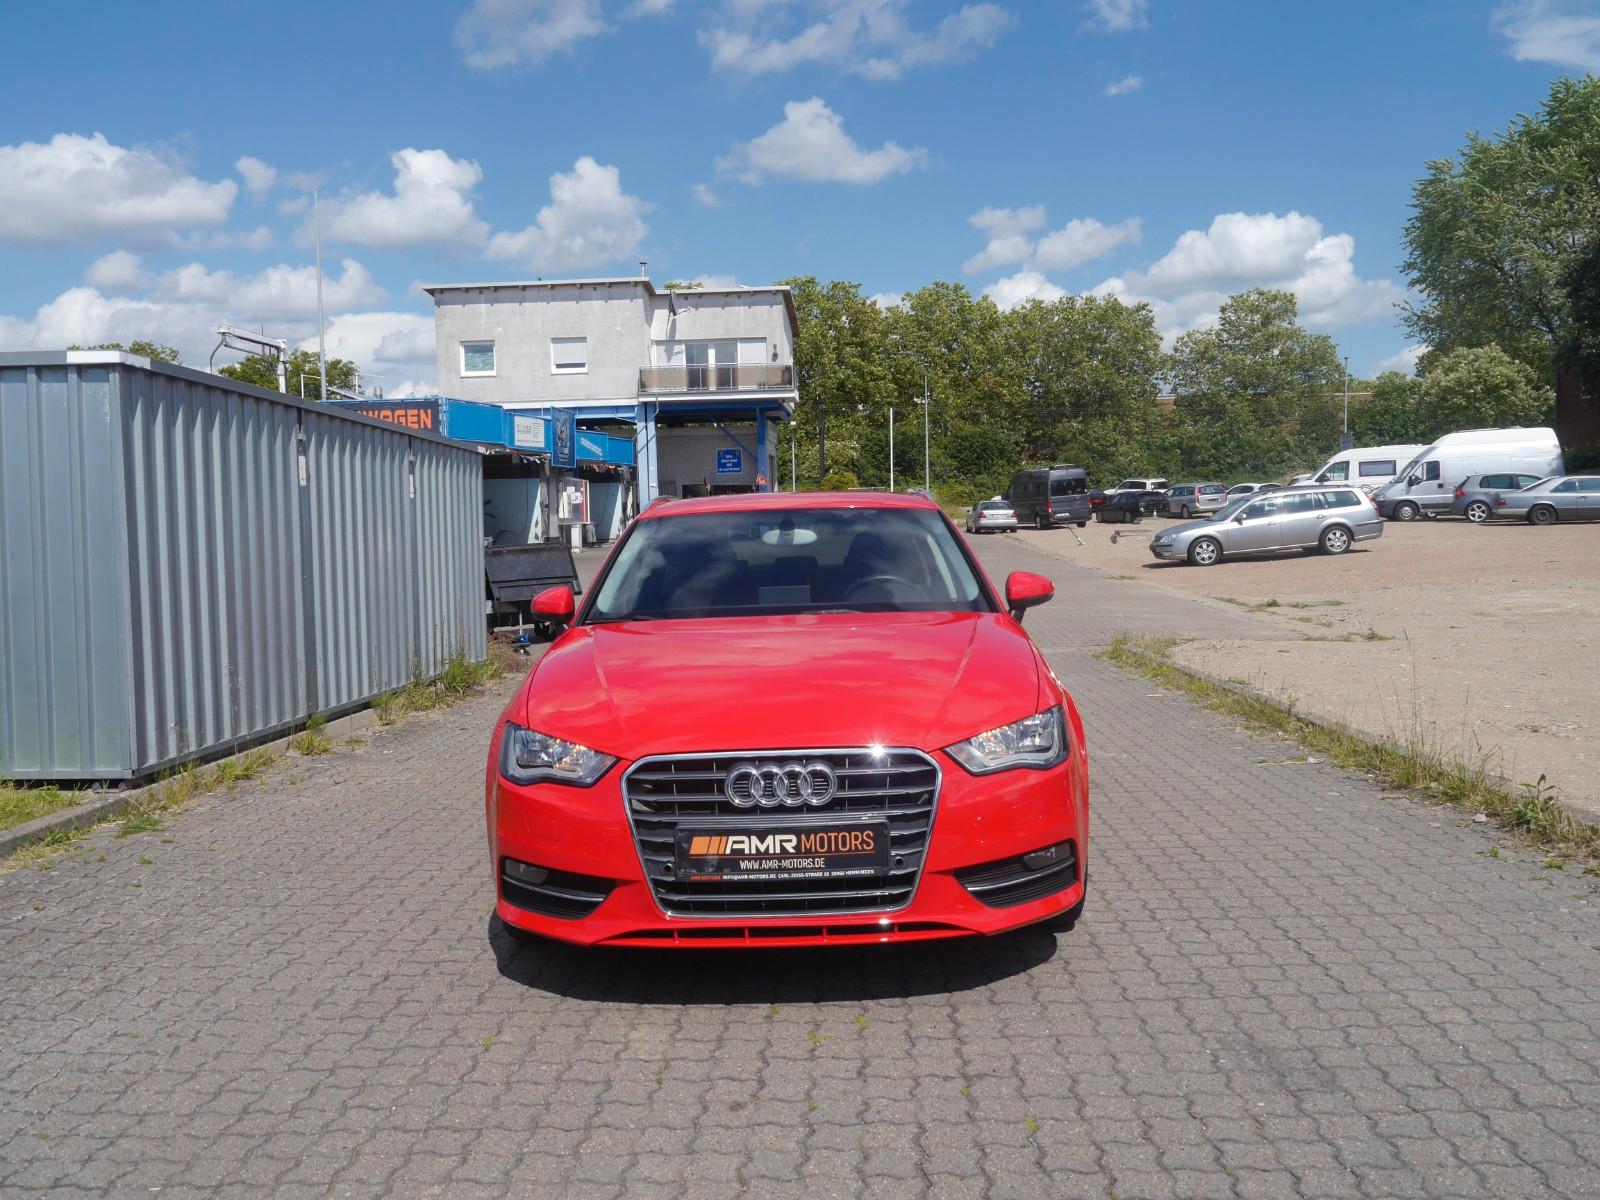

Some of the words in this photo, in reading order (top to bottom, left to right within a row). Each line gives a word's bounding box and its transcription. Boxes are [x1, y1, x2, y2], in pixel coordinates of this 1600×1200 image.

[725, 833, 798, 855] AMR
[801, 830, 874, 853] MOTORS
[739, 857, 826, 870] WWW.AMR-MOTORS.DE
